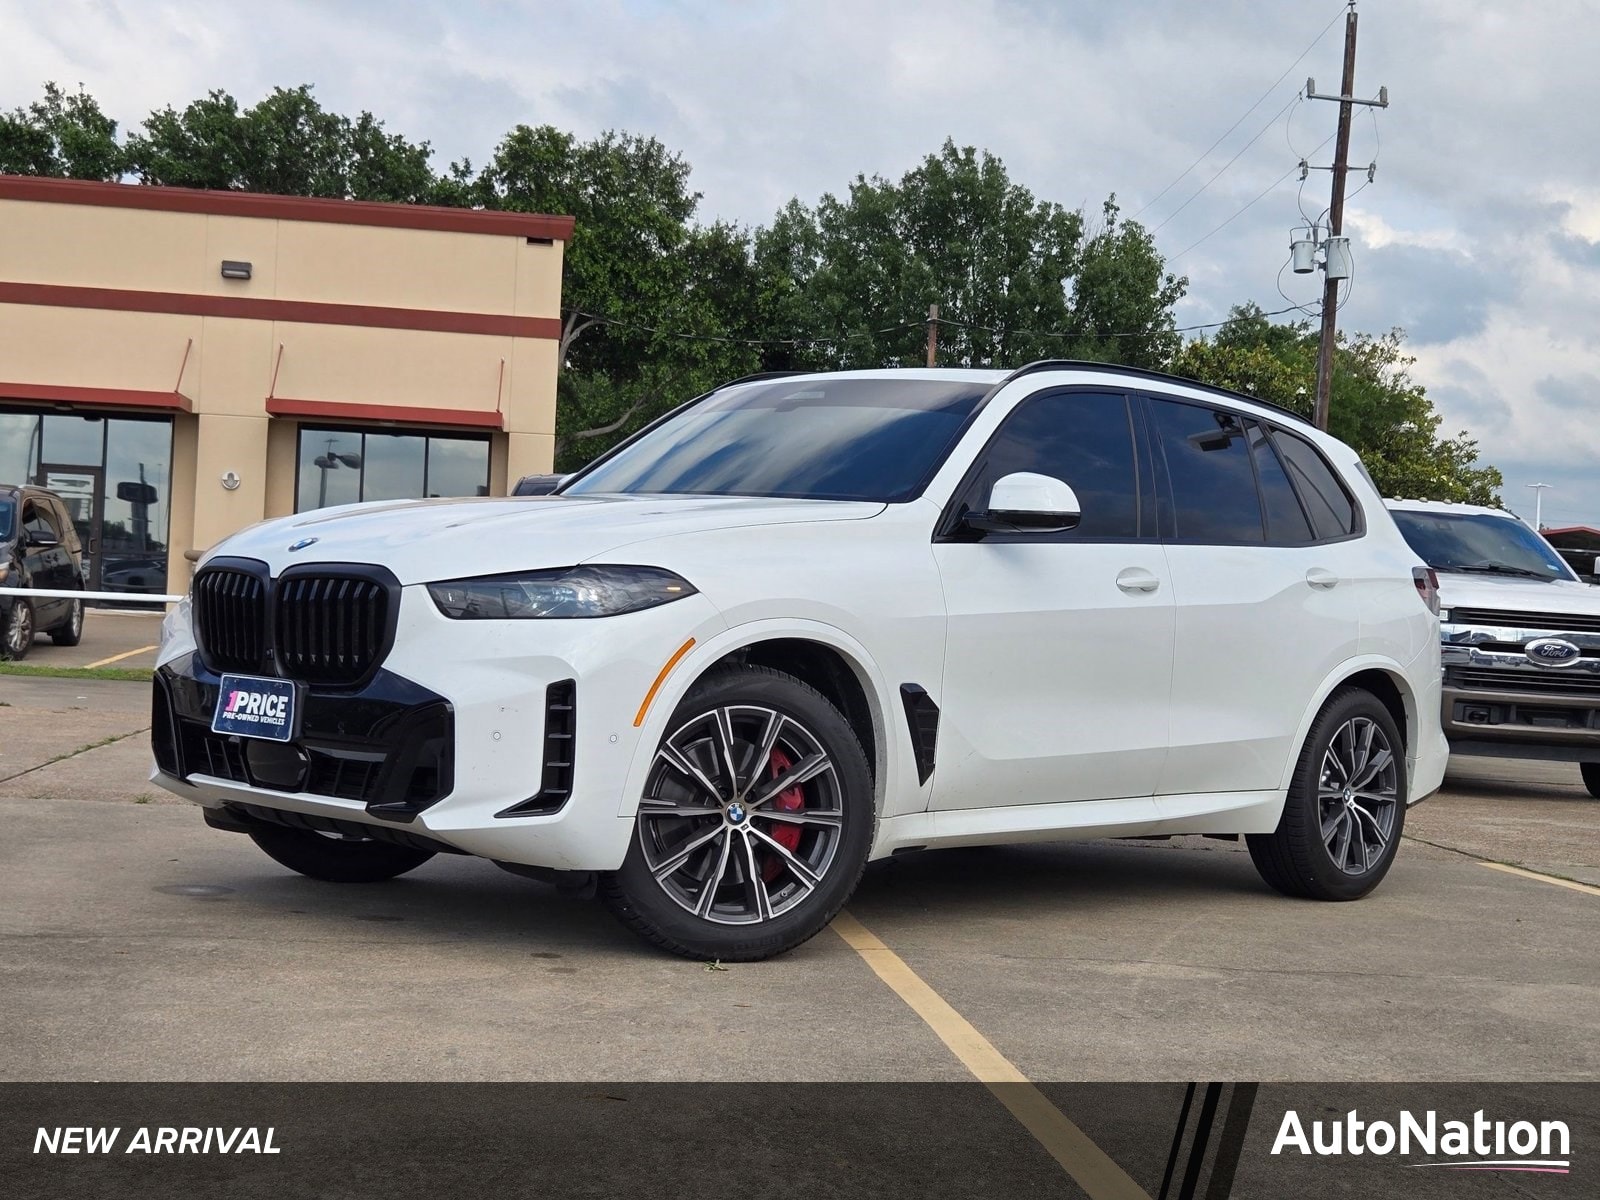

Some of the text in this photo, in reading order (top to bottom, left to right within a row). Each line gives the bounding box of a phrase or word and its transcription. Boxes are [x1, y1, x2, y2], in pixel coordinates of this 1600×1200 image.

[1541, 644, 1568, 657] Ford
[225, 690, 289, 717] 1PRICE
[222, 711, 285, 725] PRE-OWNED VEHICLES
